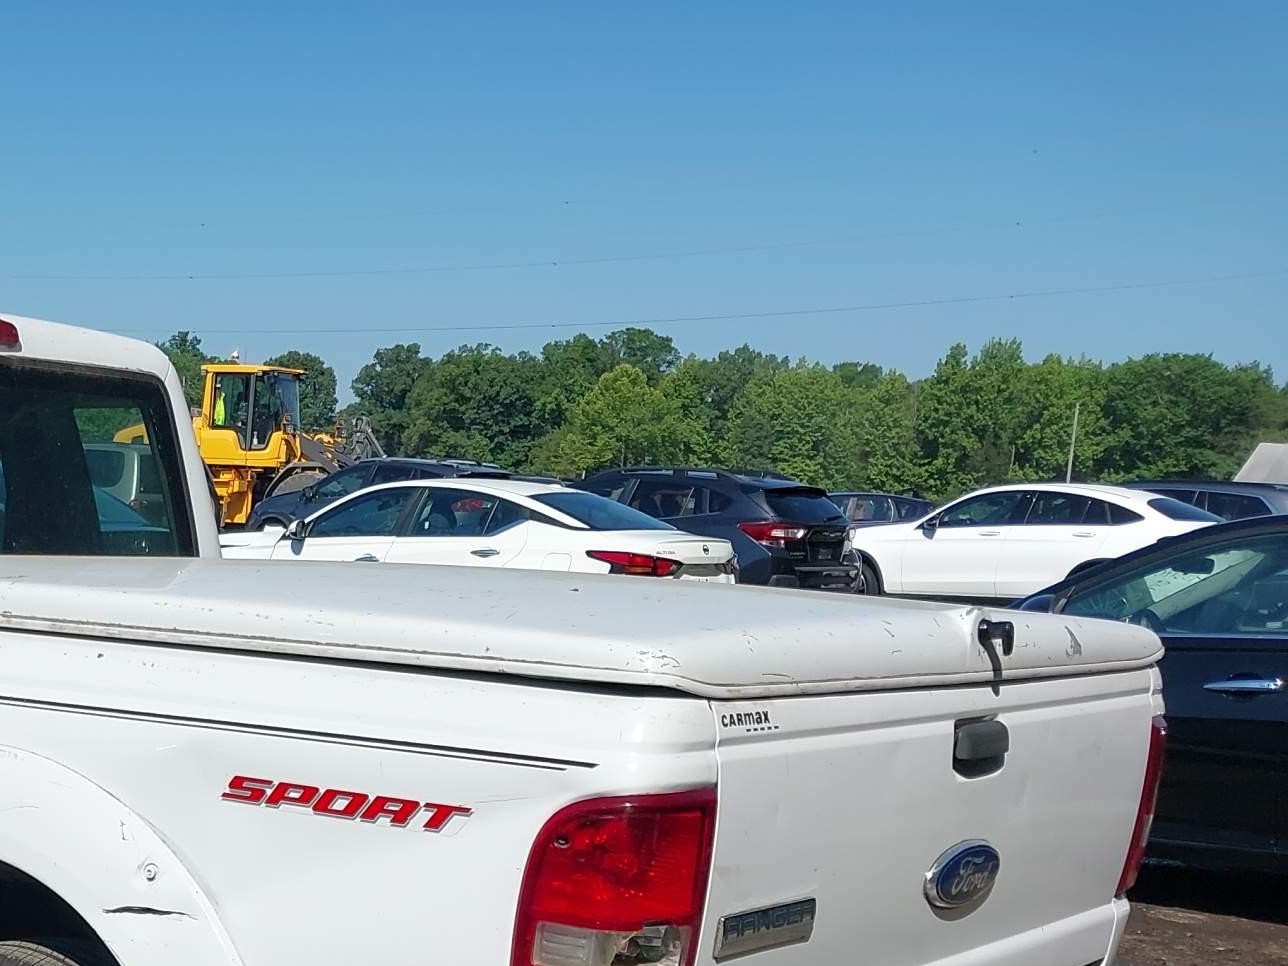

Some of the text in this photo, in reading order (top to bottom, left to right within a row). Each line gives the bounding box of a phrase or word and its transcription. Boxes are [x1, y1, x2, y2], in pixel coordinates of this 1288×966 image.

[220, 775, 474, 833] SPORT
[951, 855, 993, 896] Ford
[722, 904, 815, 942] RANGER
